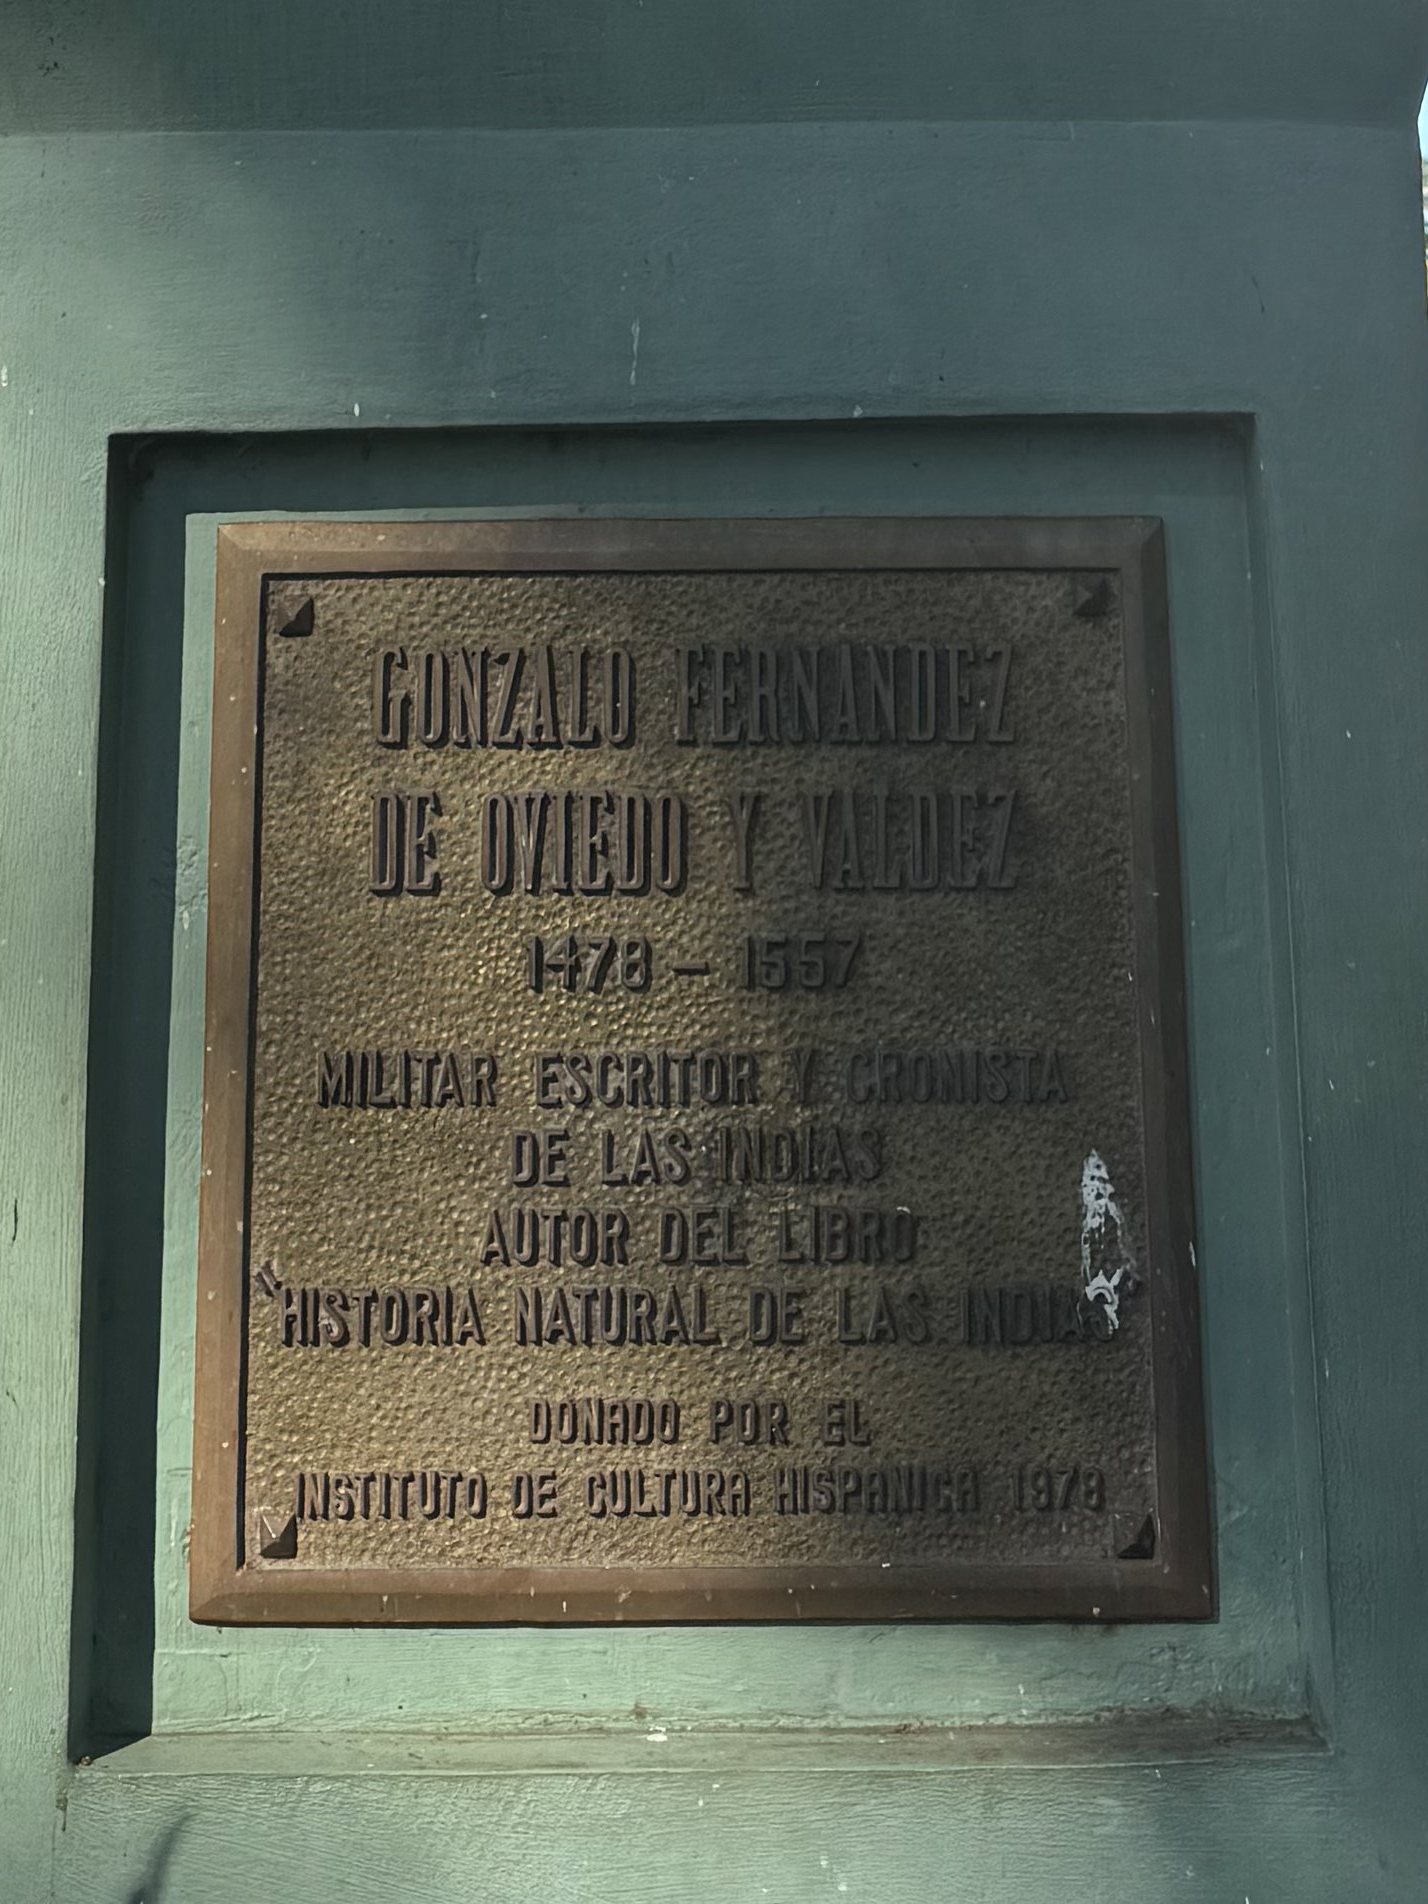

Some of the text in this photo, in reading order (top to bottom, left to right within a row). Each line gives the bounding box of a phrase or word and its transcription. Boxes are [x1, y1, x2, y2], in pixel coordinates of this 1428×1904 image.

[376, 642, 1018, 748] GONZALO FERNANDEZ
[370, 788, 1020, 897] DE OVIEDO Y VALDEZ
[528, 935, 651, 993] 1478
[740, 930, 862, 991] 1557
[316, 1045, 1070, 1108] MILITAR ESCRITOR Y CRONISTA
[511, 1123, 883, 1187] DE LAS INDIAS
[480, 1205, 918, 1267] AUTOR DEL LIBRO
[256, 1265, 487, 1348] "HISTORIA
[514, 1284, 721, 1348] NATURAL
[749, 1284, 806, 1346] DE
[836, 1283, 933, 1345] LAS
[529, 1398, 872, 1446] DONADO POR EL
[293, 1465, 1107, 1521] INSTITUTO DE CULTURA HISPANICA 1978
